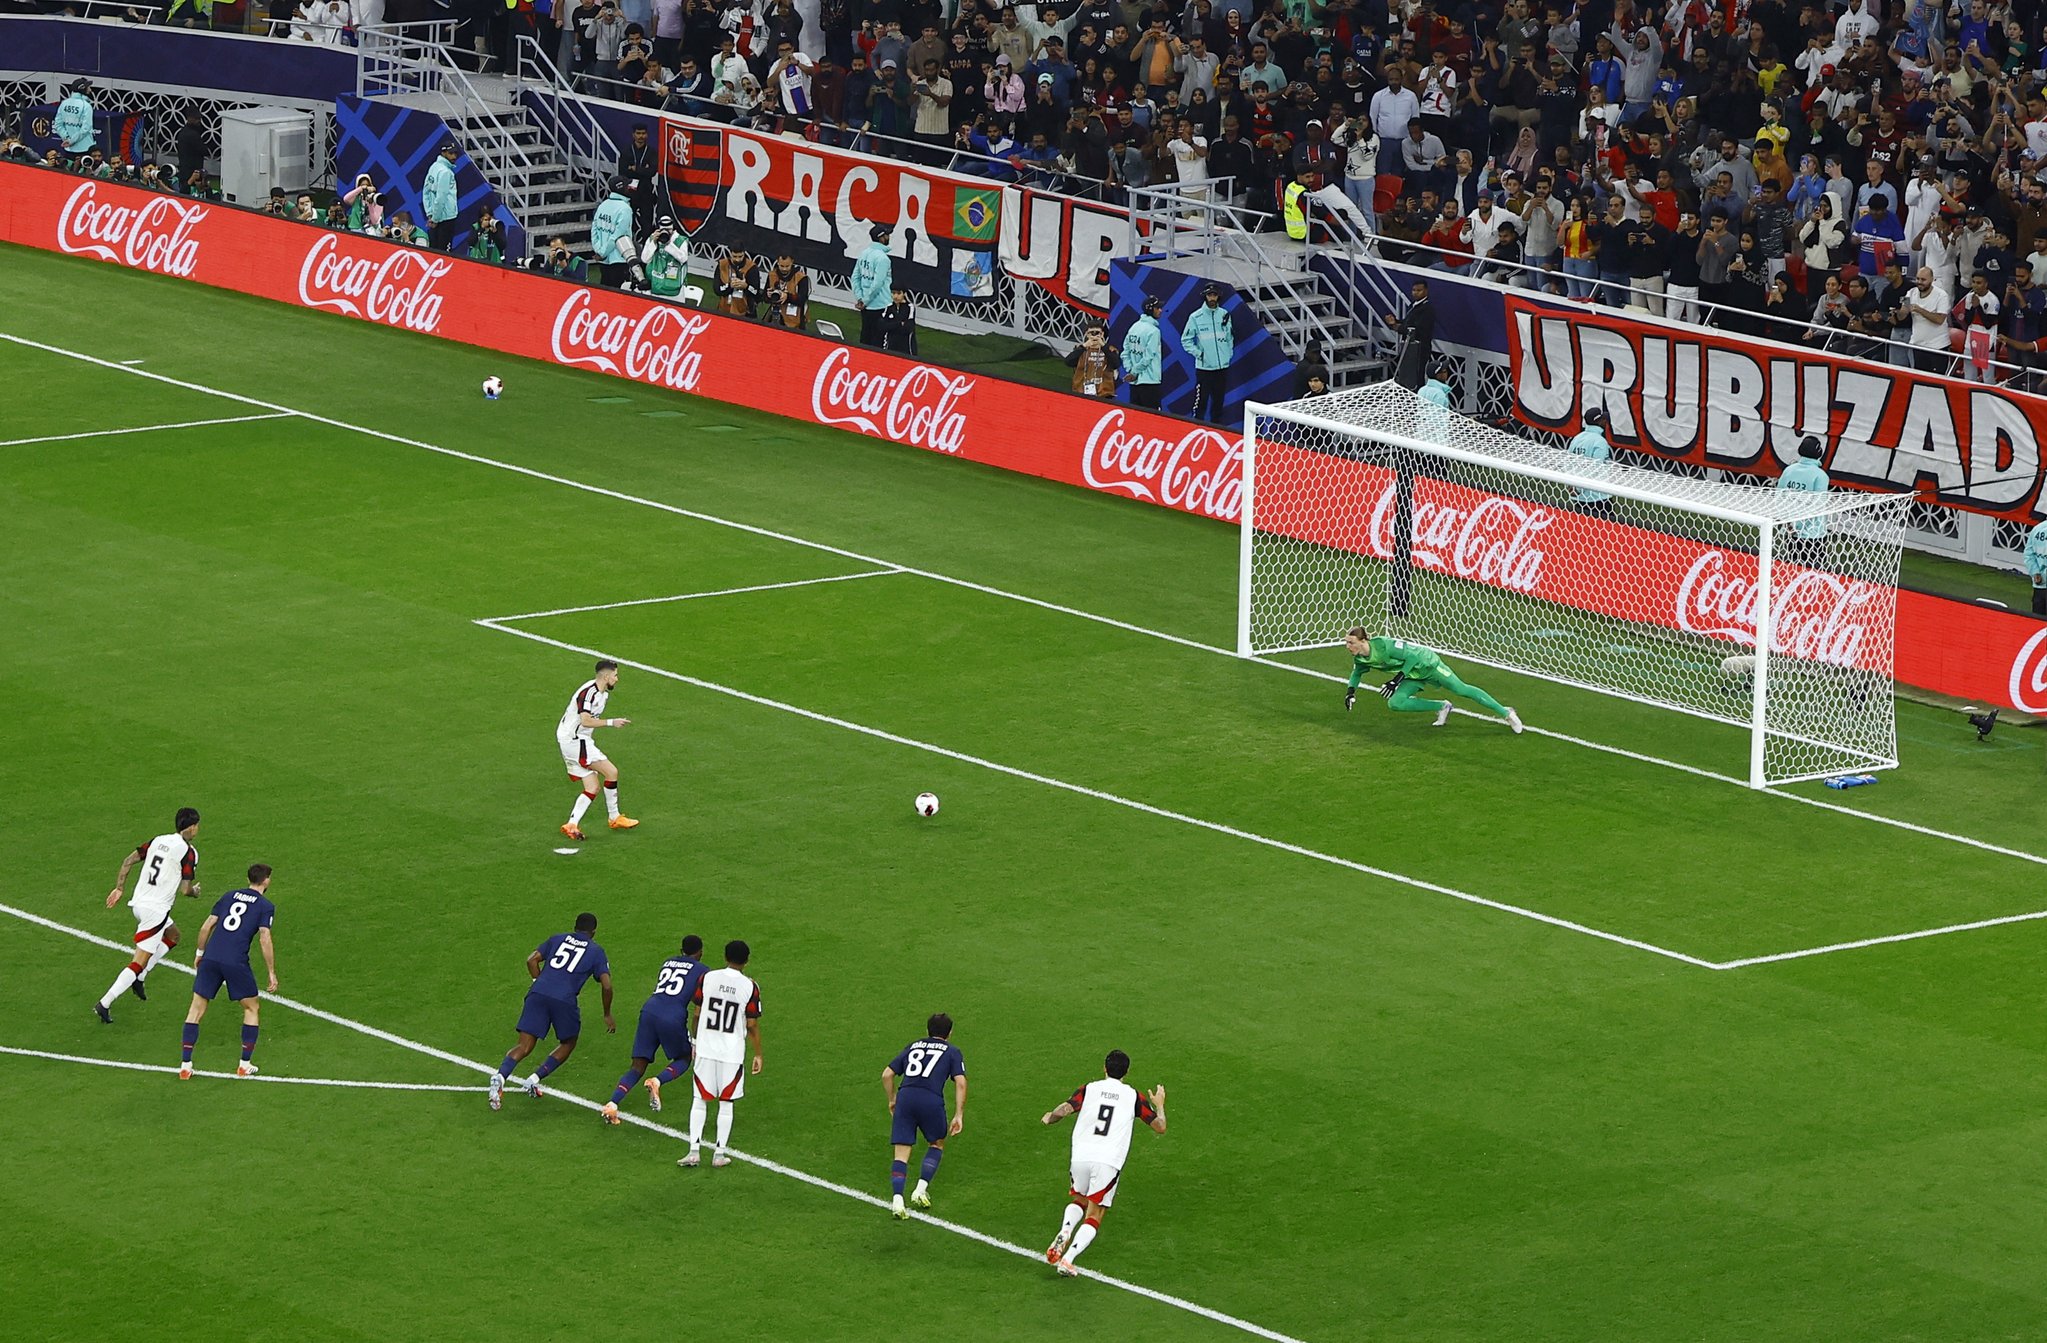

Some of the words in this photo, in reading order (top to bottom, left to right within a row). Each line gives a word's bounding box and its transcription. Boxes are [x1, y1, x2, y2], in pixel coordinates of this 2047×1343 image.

[57, 182, 209, 277] Coca-Cola
[298, 234, 453, 333] Coca-Cola
[551, 289, 711, 392] Coca-Cola
[812, 347, 975, 454] Coca-Cola
[1513, 308, 2047, 518] URUBUZAD
[2034, 531, 2047, 542] 48
[147, 854, 165, 886] 5
[222, 901, 248, 932] 8
[549, 941, 587, 973] 51
[653, 967, 689, 996] 25
[706, 997, 740, 1034] 50
[905, 1048, 944, 1078] 87
[1093, 1104, 1115, 1137] 9
